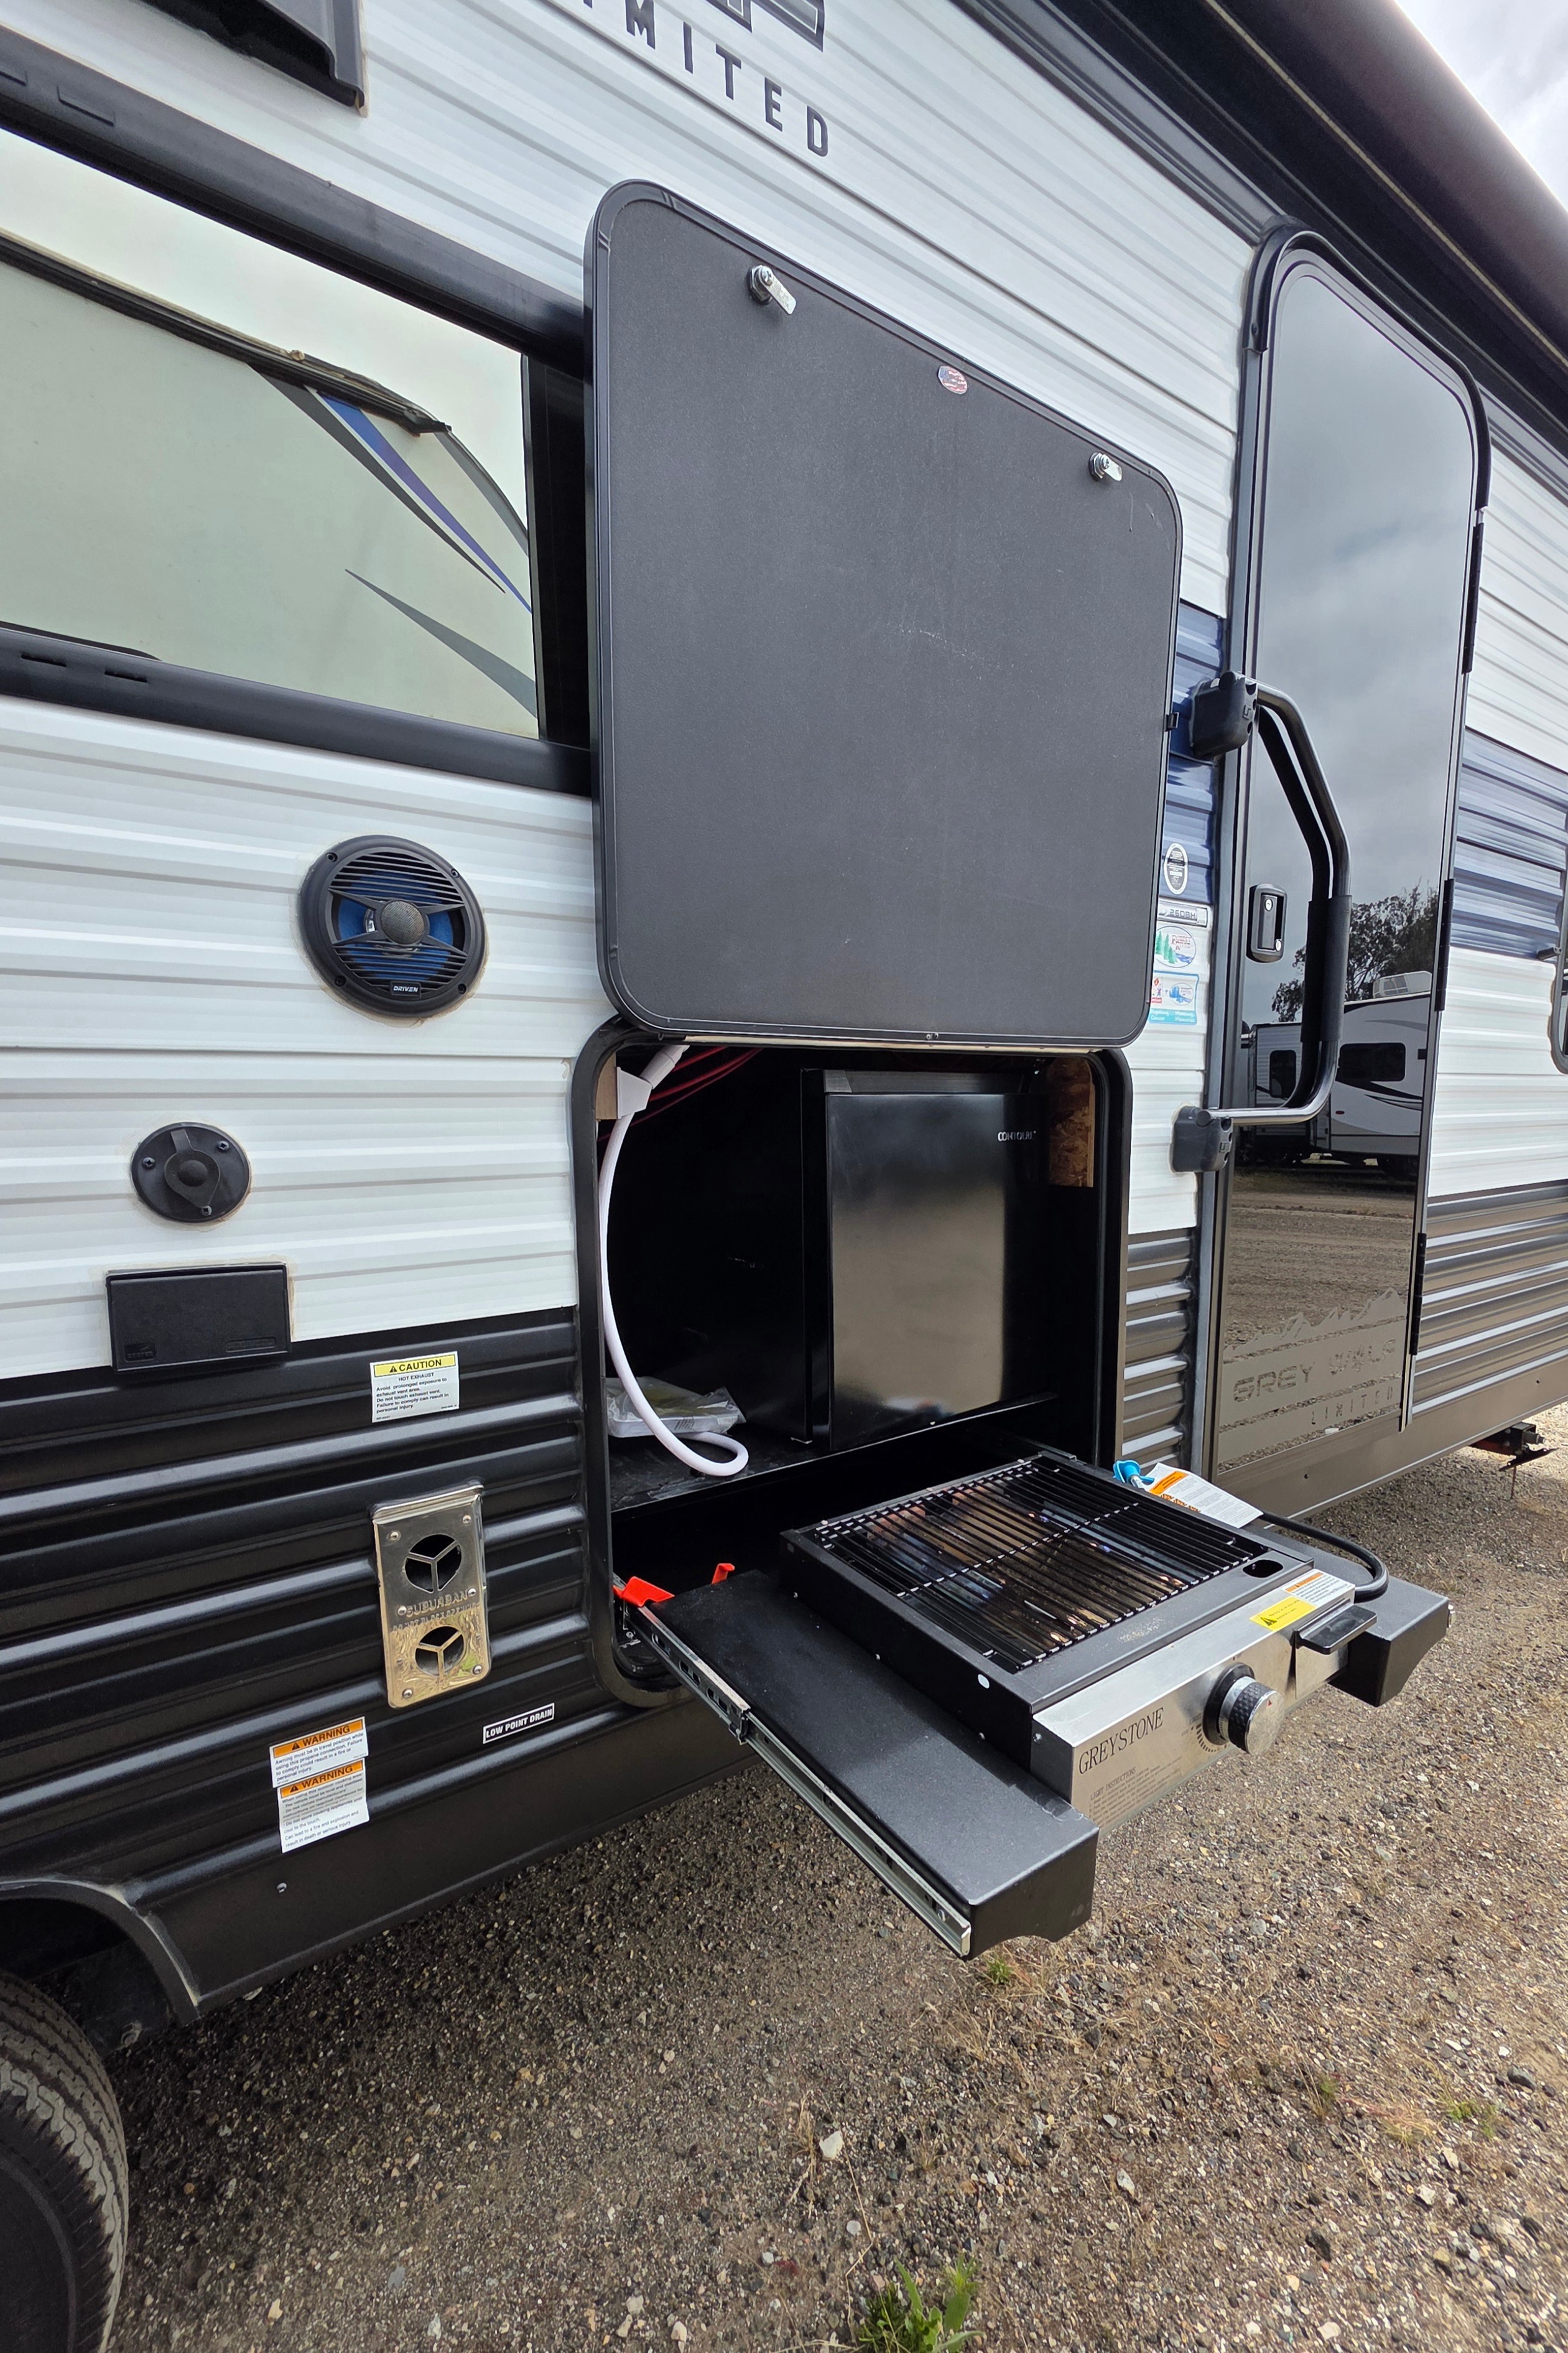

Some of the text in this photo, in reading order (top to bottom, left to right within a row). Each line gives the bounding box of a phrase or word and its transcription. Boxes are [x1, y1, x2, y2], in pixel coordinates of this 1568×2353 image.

[583, 0, 828, 156] MITED
[399, 1359, 442, 1371] CAUTION
[486, 1708, 552, 1738] LOW POINT DRAIN
[302, 1725, 350, 1747] WARNING
[1079, 1707, 1164, 1774] GREYSTONE
[275, 1756, 292, 1765] Awning
[333, 1736, 351, 1746] position
[300, 1753, 319, 1763] propane
[277, 1772, 297, 1782] personal
[282, 1766, 299, 1774] comply
[302, 1766, 353, 1789] WARNING
[322, 1825, 338, 1833] serious
